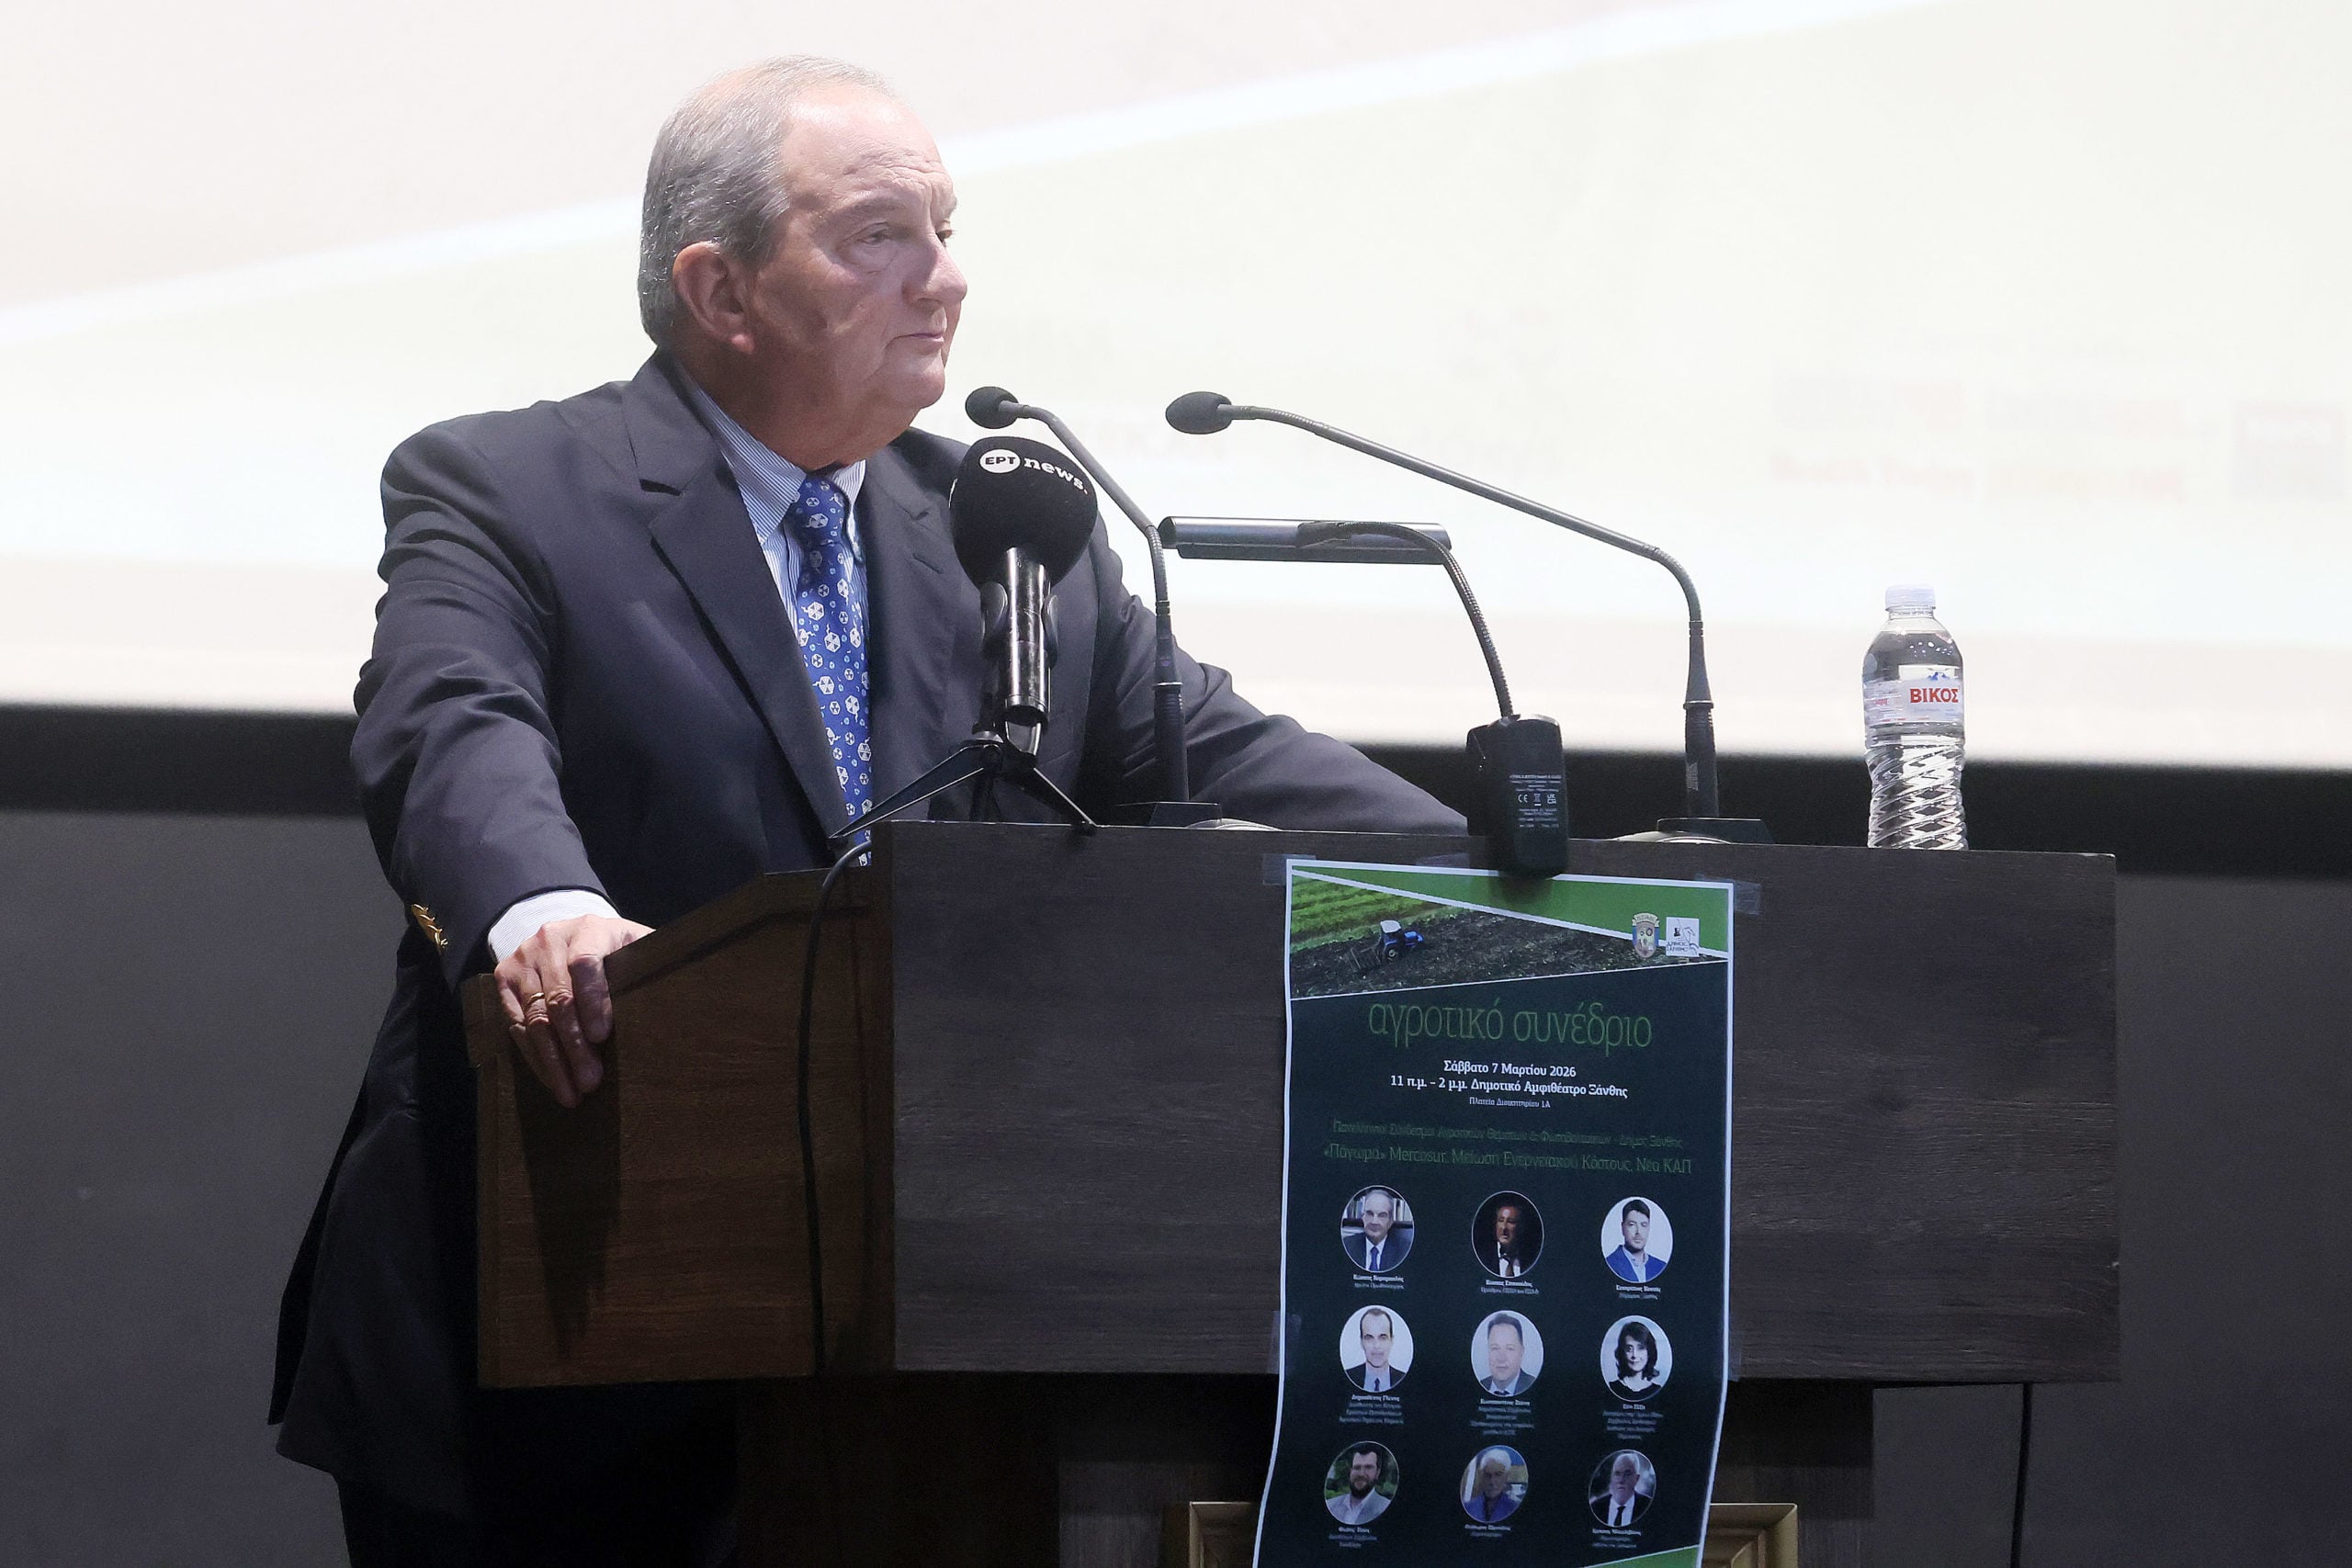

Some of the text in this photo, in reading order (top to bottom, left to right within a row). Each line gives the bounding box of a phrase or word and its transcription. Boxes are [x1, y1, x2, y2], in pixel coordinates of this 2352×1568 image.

[985, 457, 1016, 465] ΕΡΤ
[1909, 688, 1959, 704] ΒΙΚΟΣ
[1369, 998, 1652, 1057] αγροτικό συνέδριο
[1443, 1060, 1577, 1077] Σάββατο 7 Μαρτίου 2026
[1391, 1075, 1404, 1087] 11
[1438, 1077, 1445, 1089] 2
[1470, 1078, 1521, 1093] Δημοτικό
[1523, 1080, 1587, 1097] Αμφιθέατρο
[1588, 1084, 1629, 1099] Ξάνθης
[1663, 1158, 1691, 1175] ΚΑΠ
